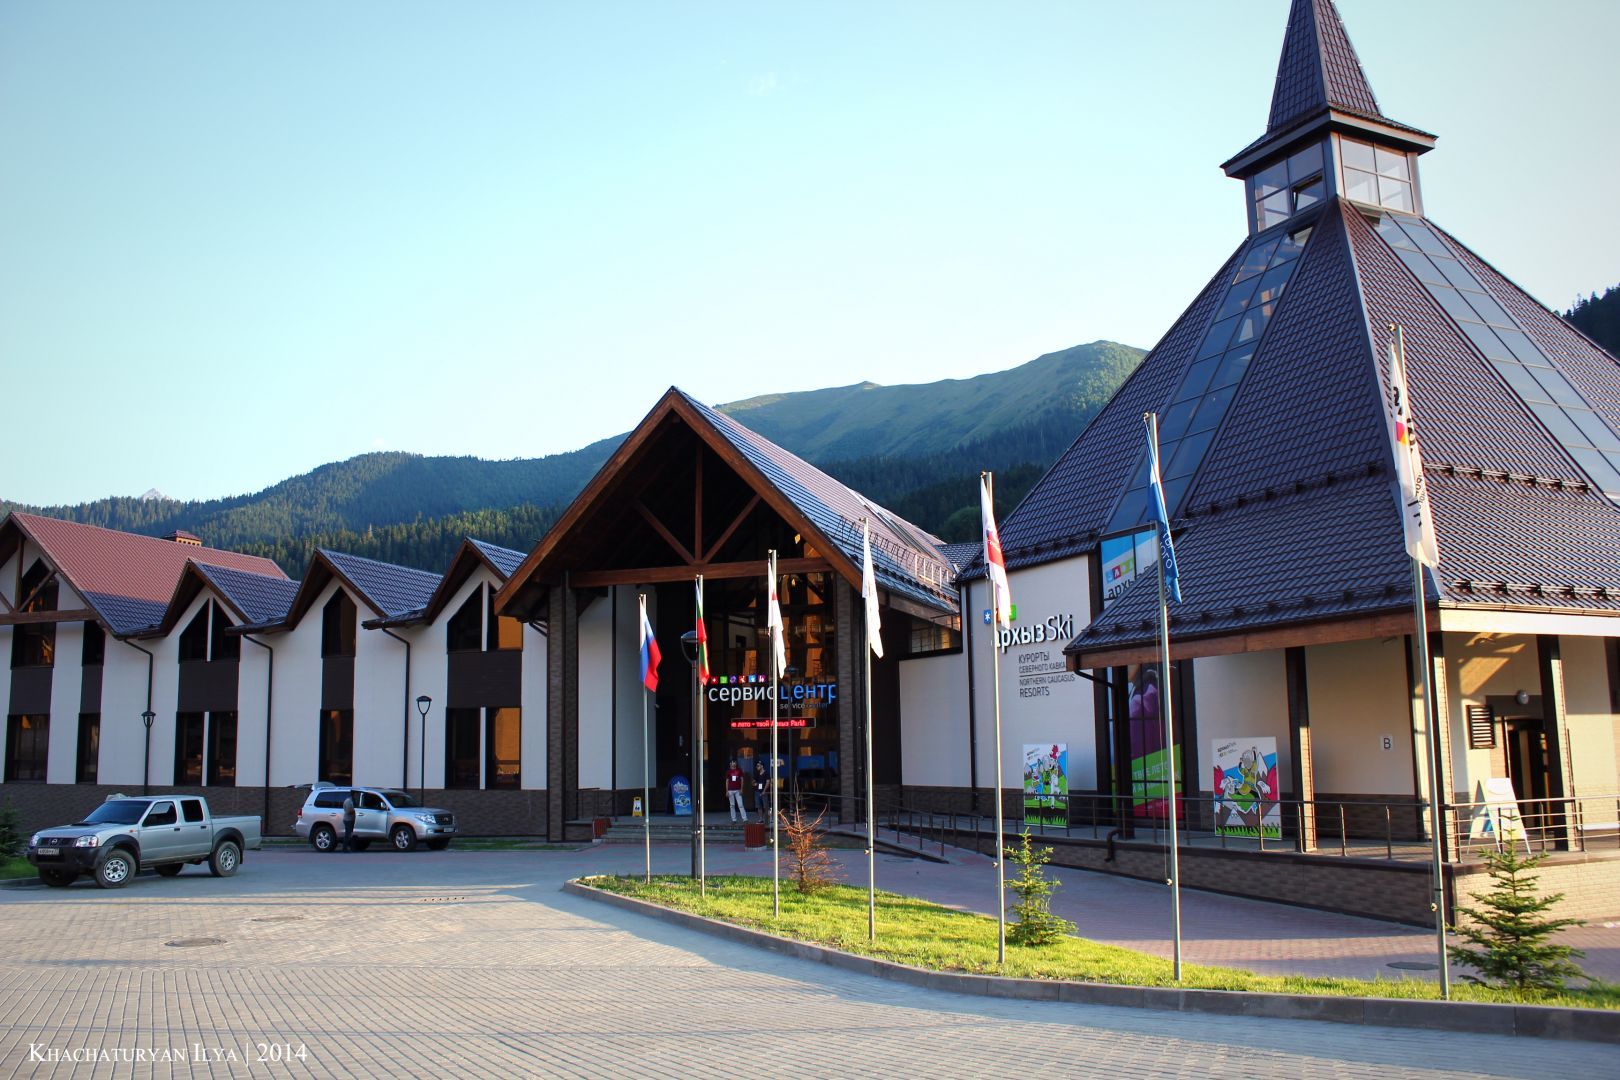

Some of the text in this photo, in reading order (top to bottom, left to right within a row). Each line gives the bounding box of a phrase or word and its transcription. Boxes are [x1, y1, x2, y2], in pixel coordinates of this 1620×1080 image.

[1018, 651, 1050, 664] КУРОРТЫ
[1018, 661, 1066, 674] СЕВЕРНОГО КАВКА
[1019, 674, 1076, 687] NORTHERN CAUCASUS
[1019, 686, 1050, 698] RESORTS
